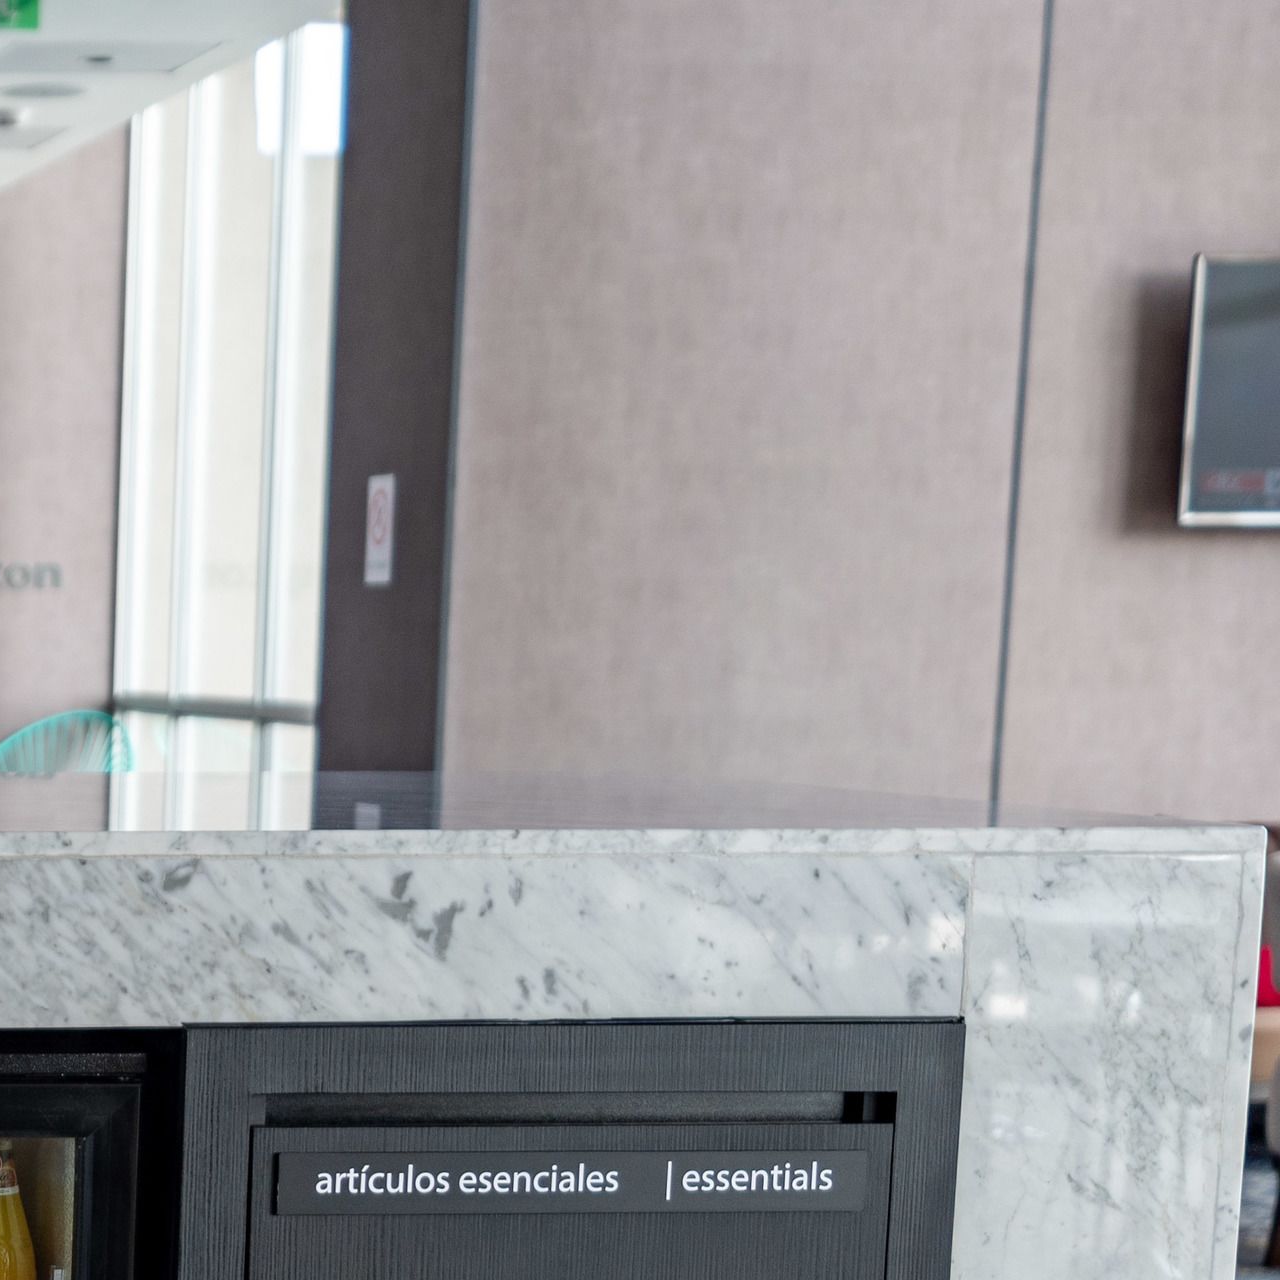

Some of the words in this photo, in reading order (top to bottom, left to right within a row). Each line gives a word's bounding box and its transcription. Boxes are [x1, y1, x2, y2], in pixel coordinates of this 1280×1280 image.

[315, 1164, 449, 1194] artículos
[458, 1163, 619, 1193] esenciales
[682, 1160, 833, 1191] essentials
